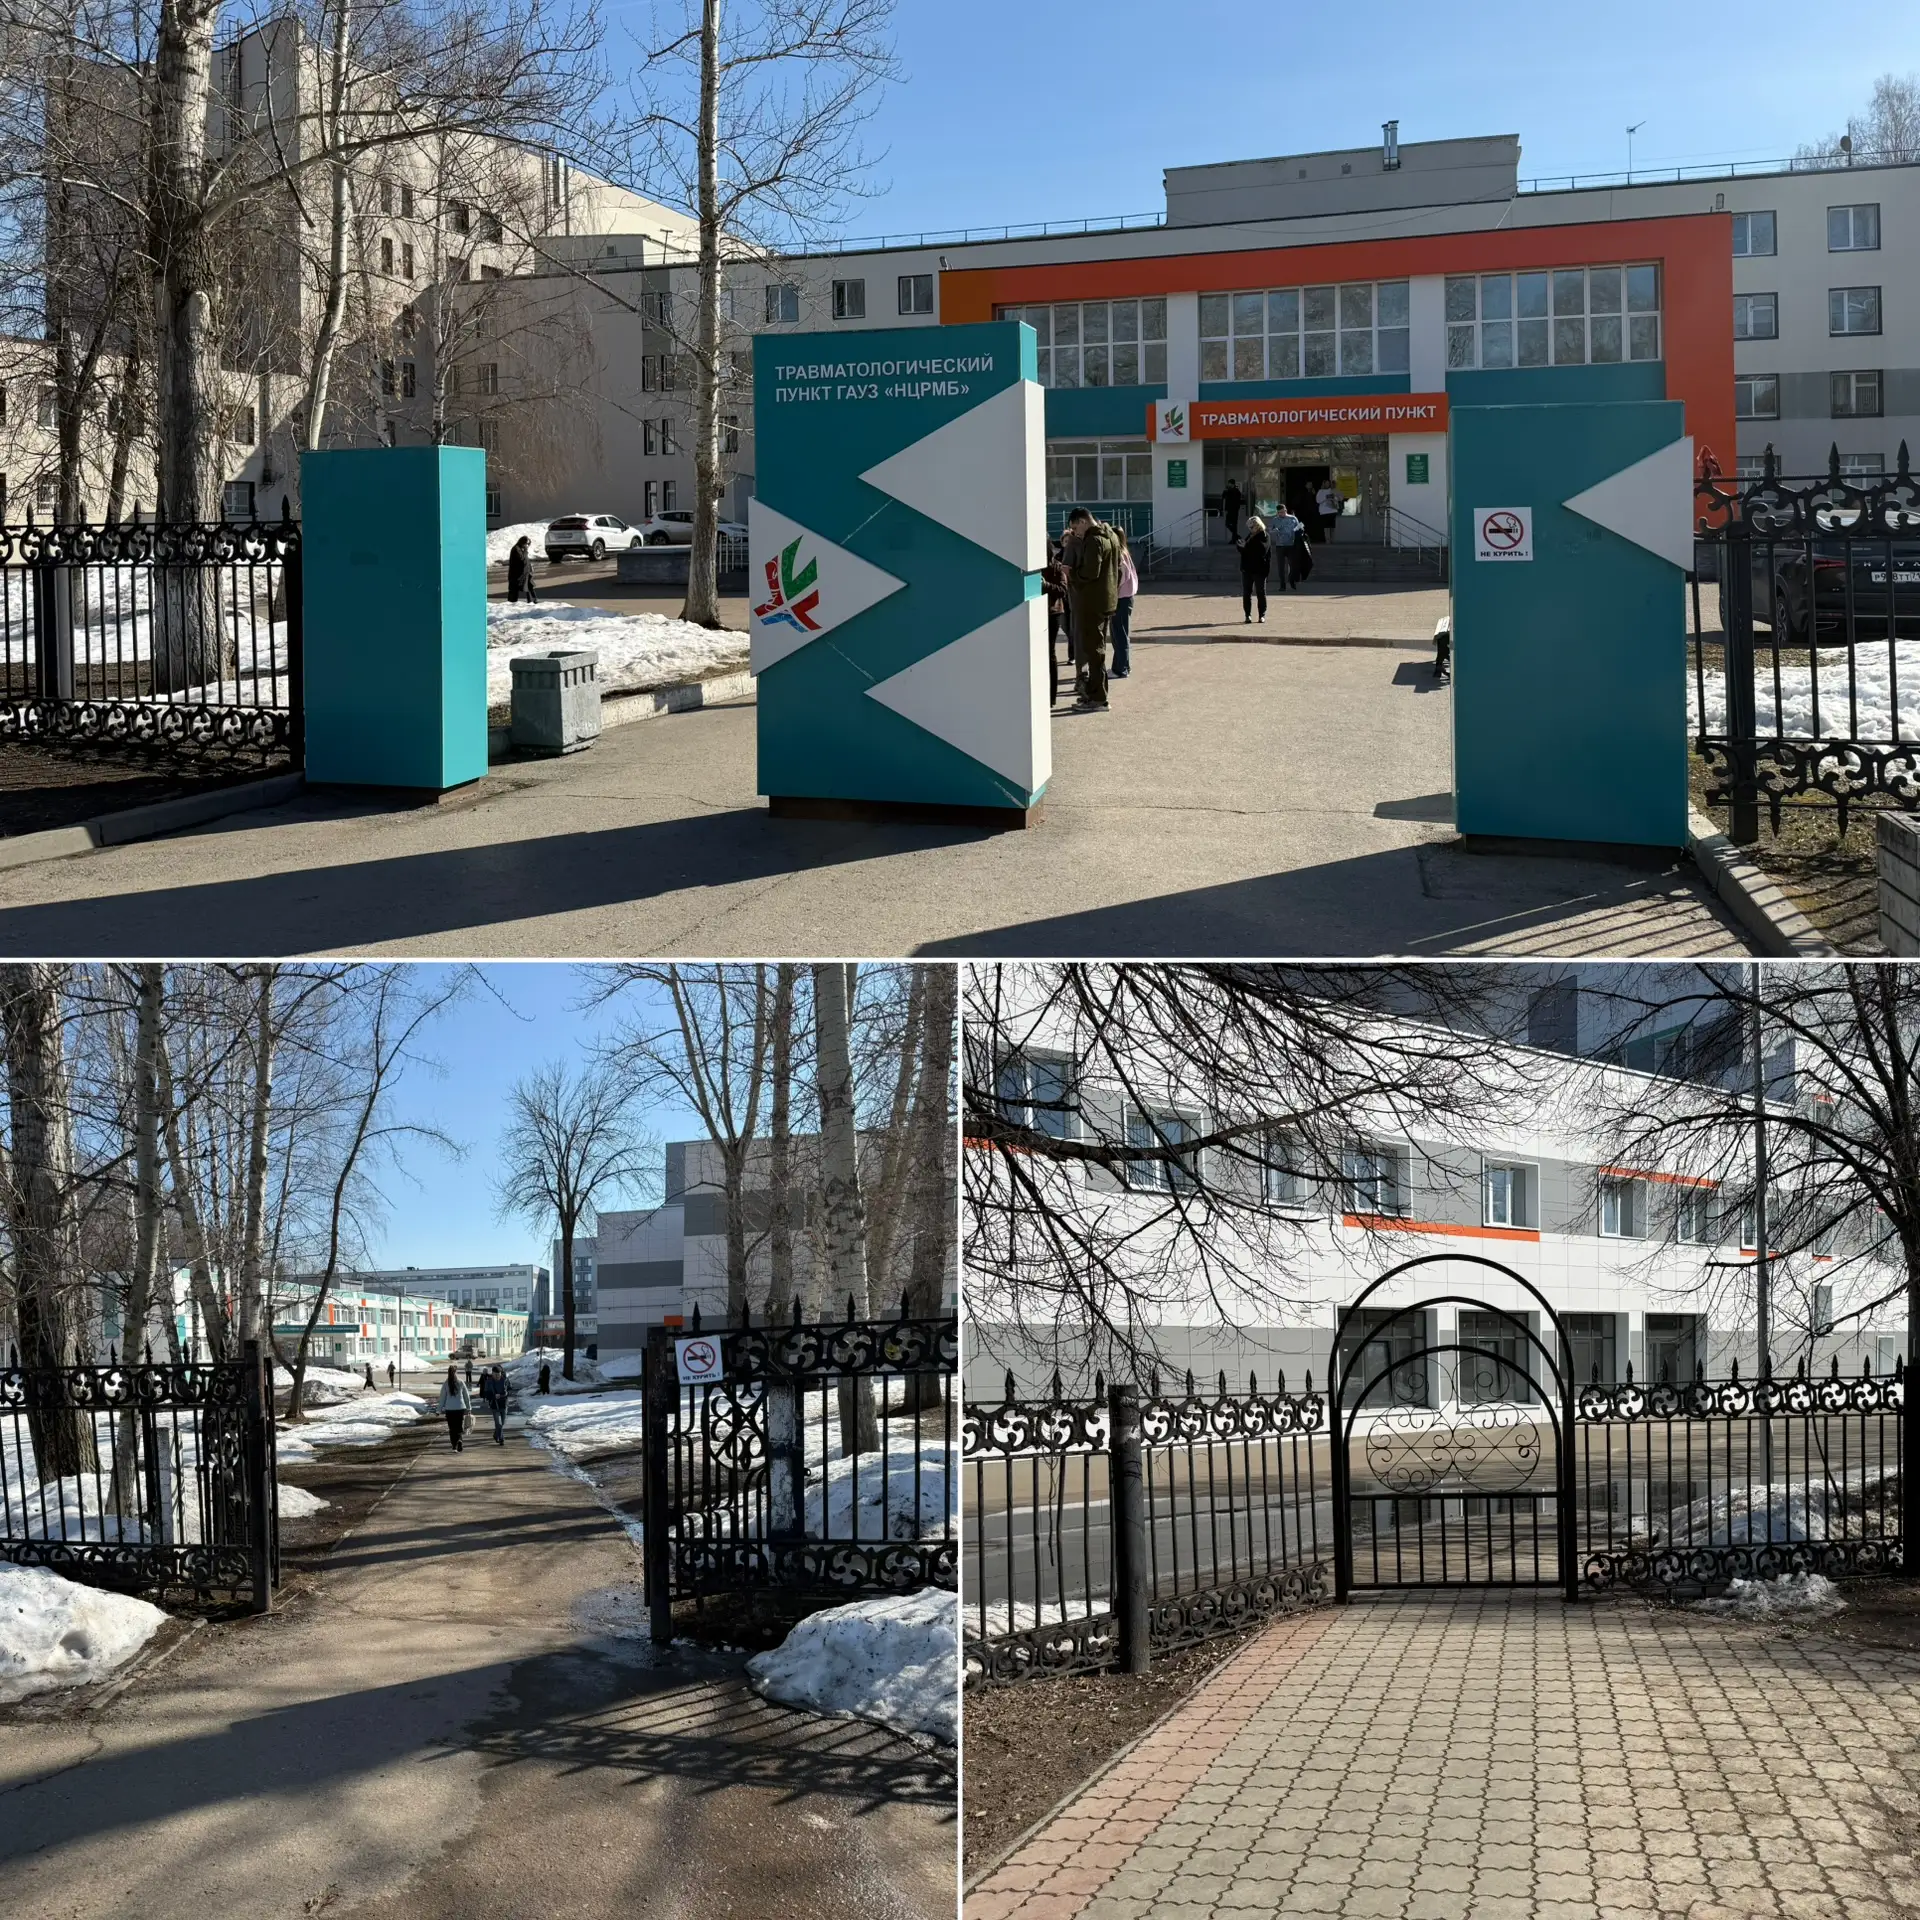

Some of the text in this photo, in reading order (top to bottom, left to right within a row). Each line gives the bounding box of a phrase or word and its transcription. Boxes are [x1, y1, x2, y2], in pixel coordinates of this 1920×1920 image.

[775, 352, 994, 381] ТРАВМАТОЛОГИЧЕСКИЙ
[775, 380, 970, 403] ПУНКТ ГАУЗ «НЦРМБ»
[1200, 405, 1437, 426] ТРАВМАТОЛОГИЧЕСКИЙ ПУНКТ
[1874, 572, 1910, 581] Р98ТТ
